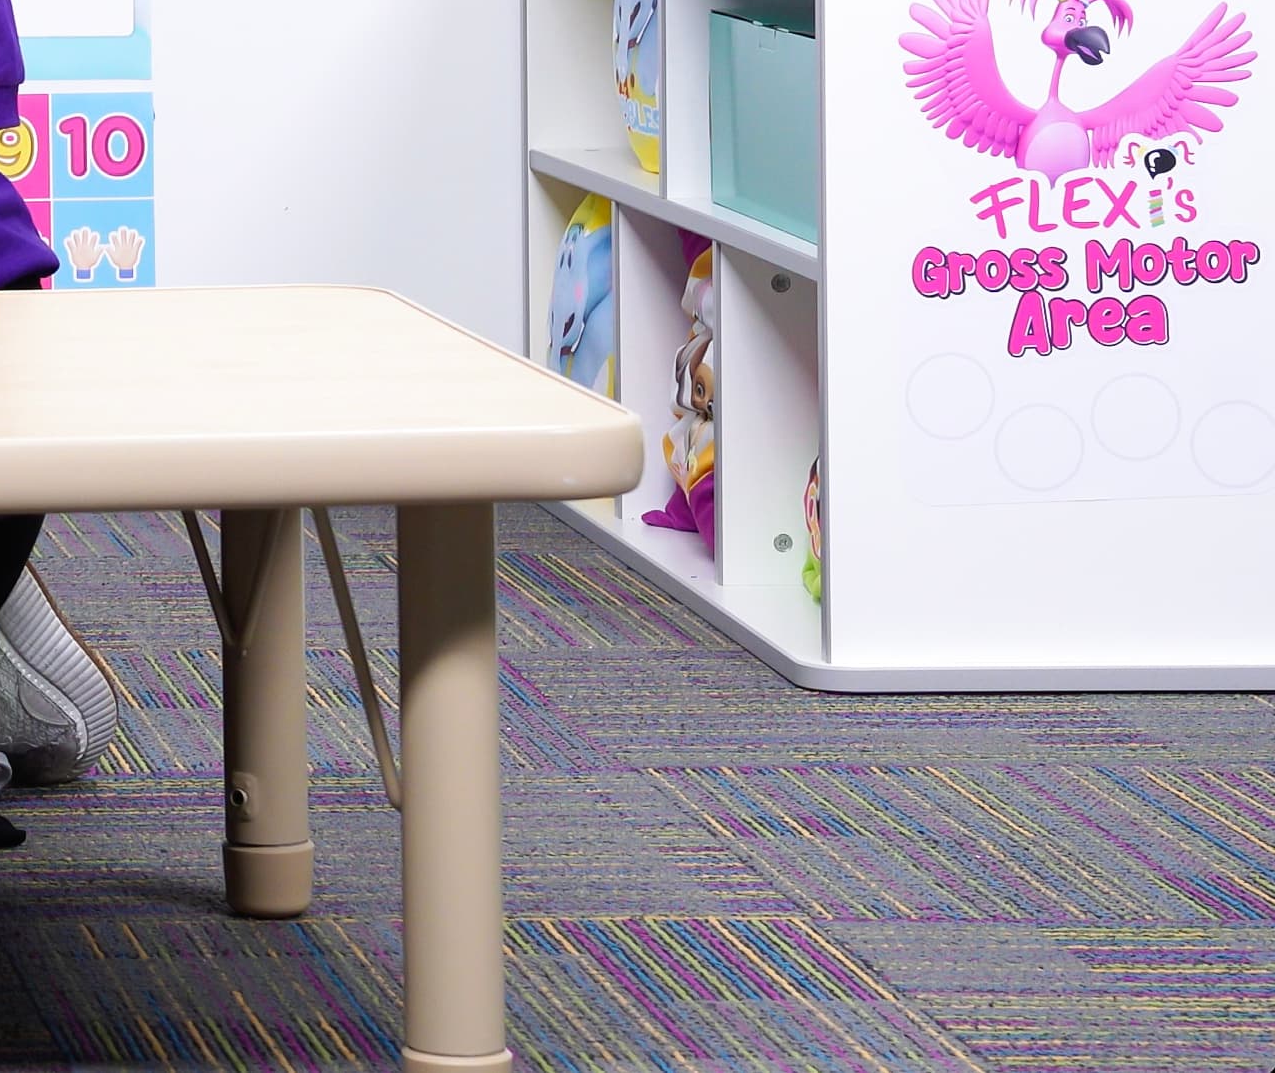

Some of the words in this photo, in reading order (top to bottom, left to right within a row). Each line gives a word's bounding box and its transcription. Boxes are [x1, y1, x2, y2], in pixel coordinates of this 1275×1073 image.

[57, 113, 146, 178] 10
[911, 246, 1068, 299] Gross
[1084, 236, 1261, 294] Motor
[1006, 289, 1170, 358] Area
